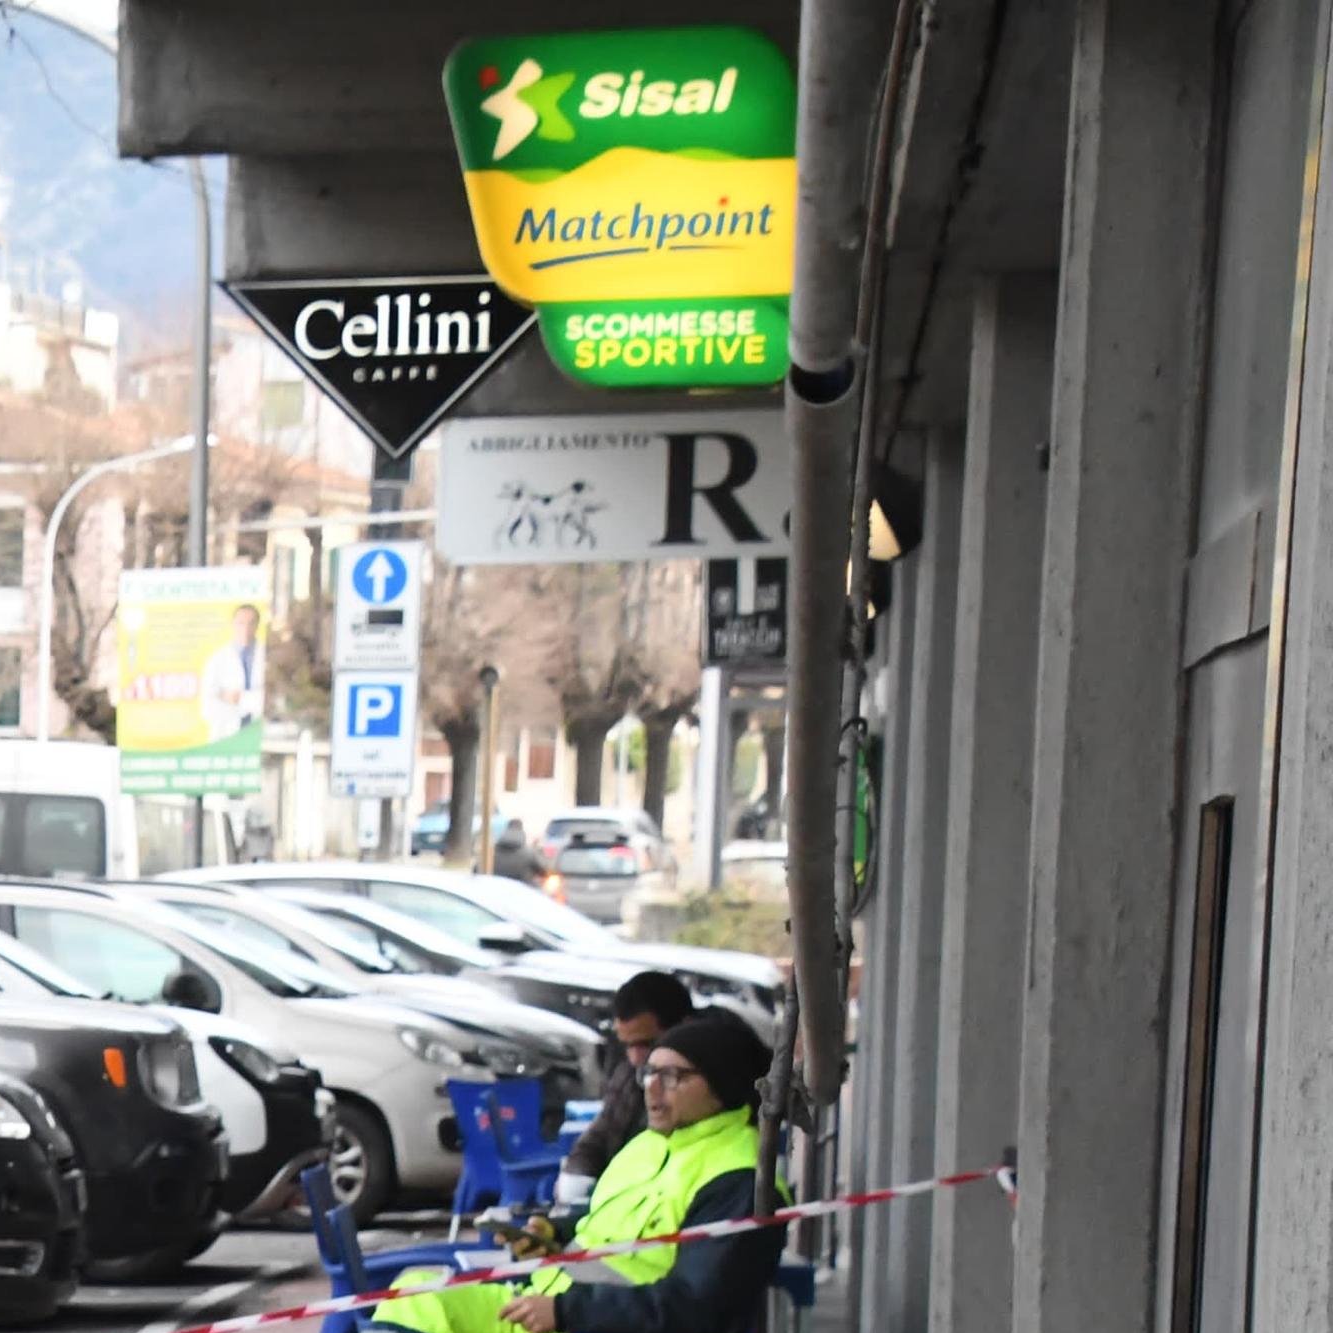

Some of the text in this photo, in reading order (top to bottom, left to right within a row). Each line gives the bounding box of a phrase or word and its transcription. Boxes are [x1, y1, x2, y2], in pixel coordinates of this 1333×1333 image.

[578, 67, 739, 120] Sisal
[513, 196, 774, 250] Matchpoint
[294, 290, 492, 360] Cellini
[565, 309, 756, 341] SCOMMESSE
[574, 334, 767, 369] SPORTIVE
